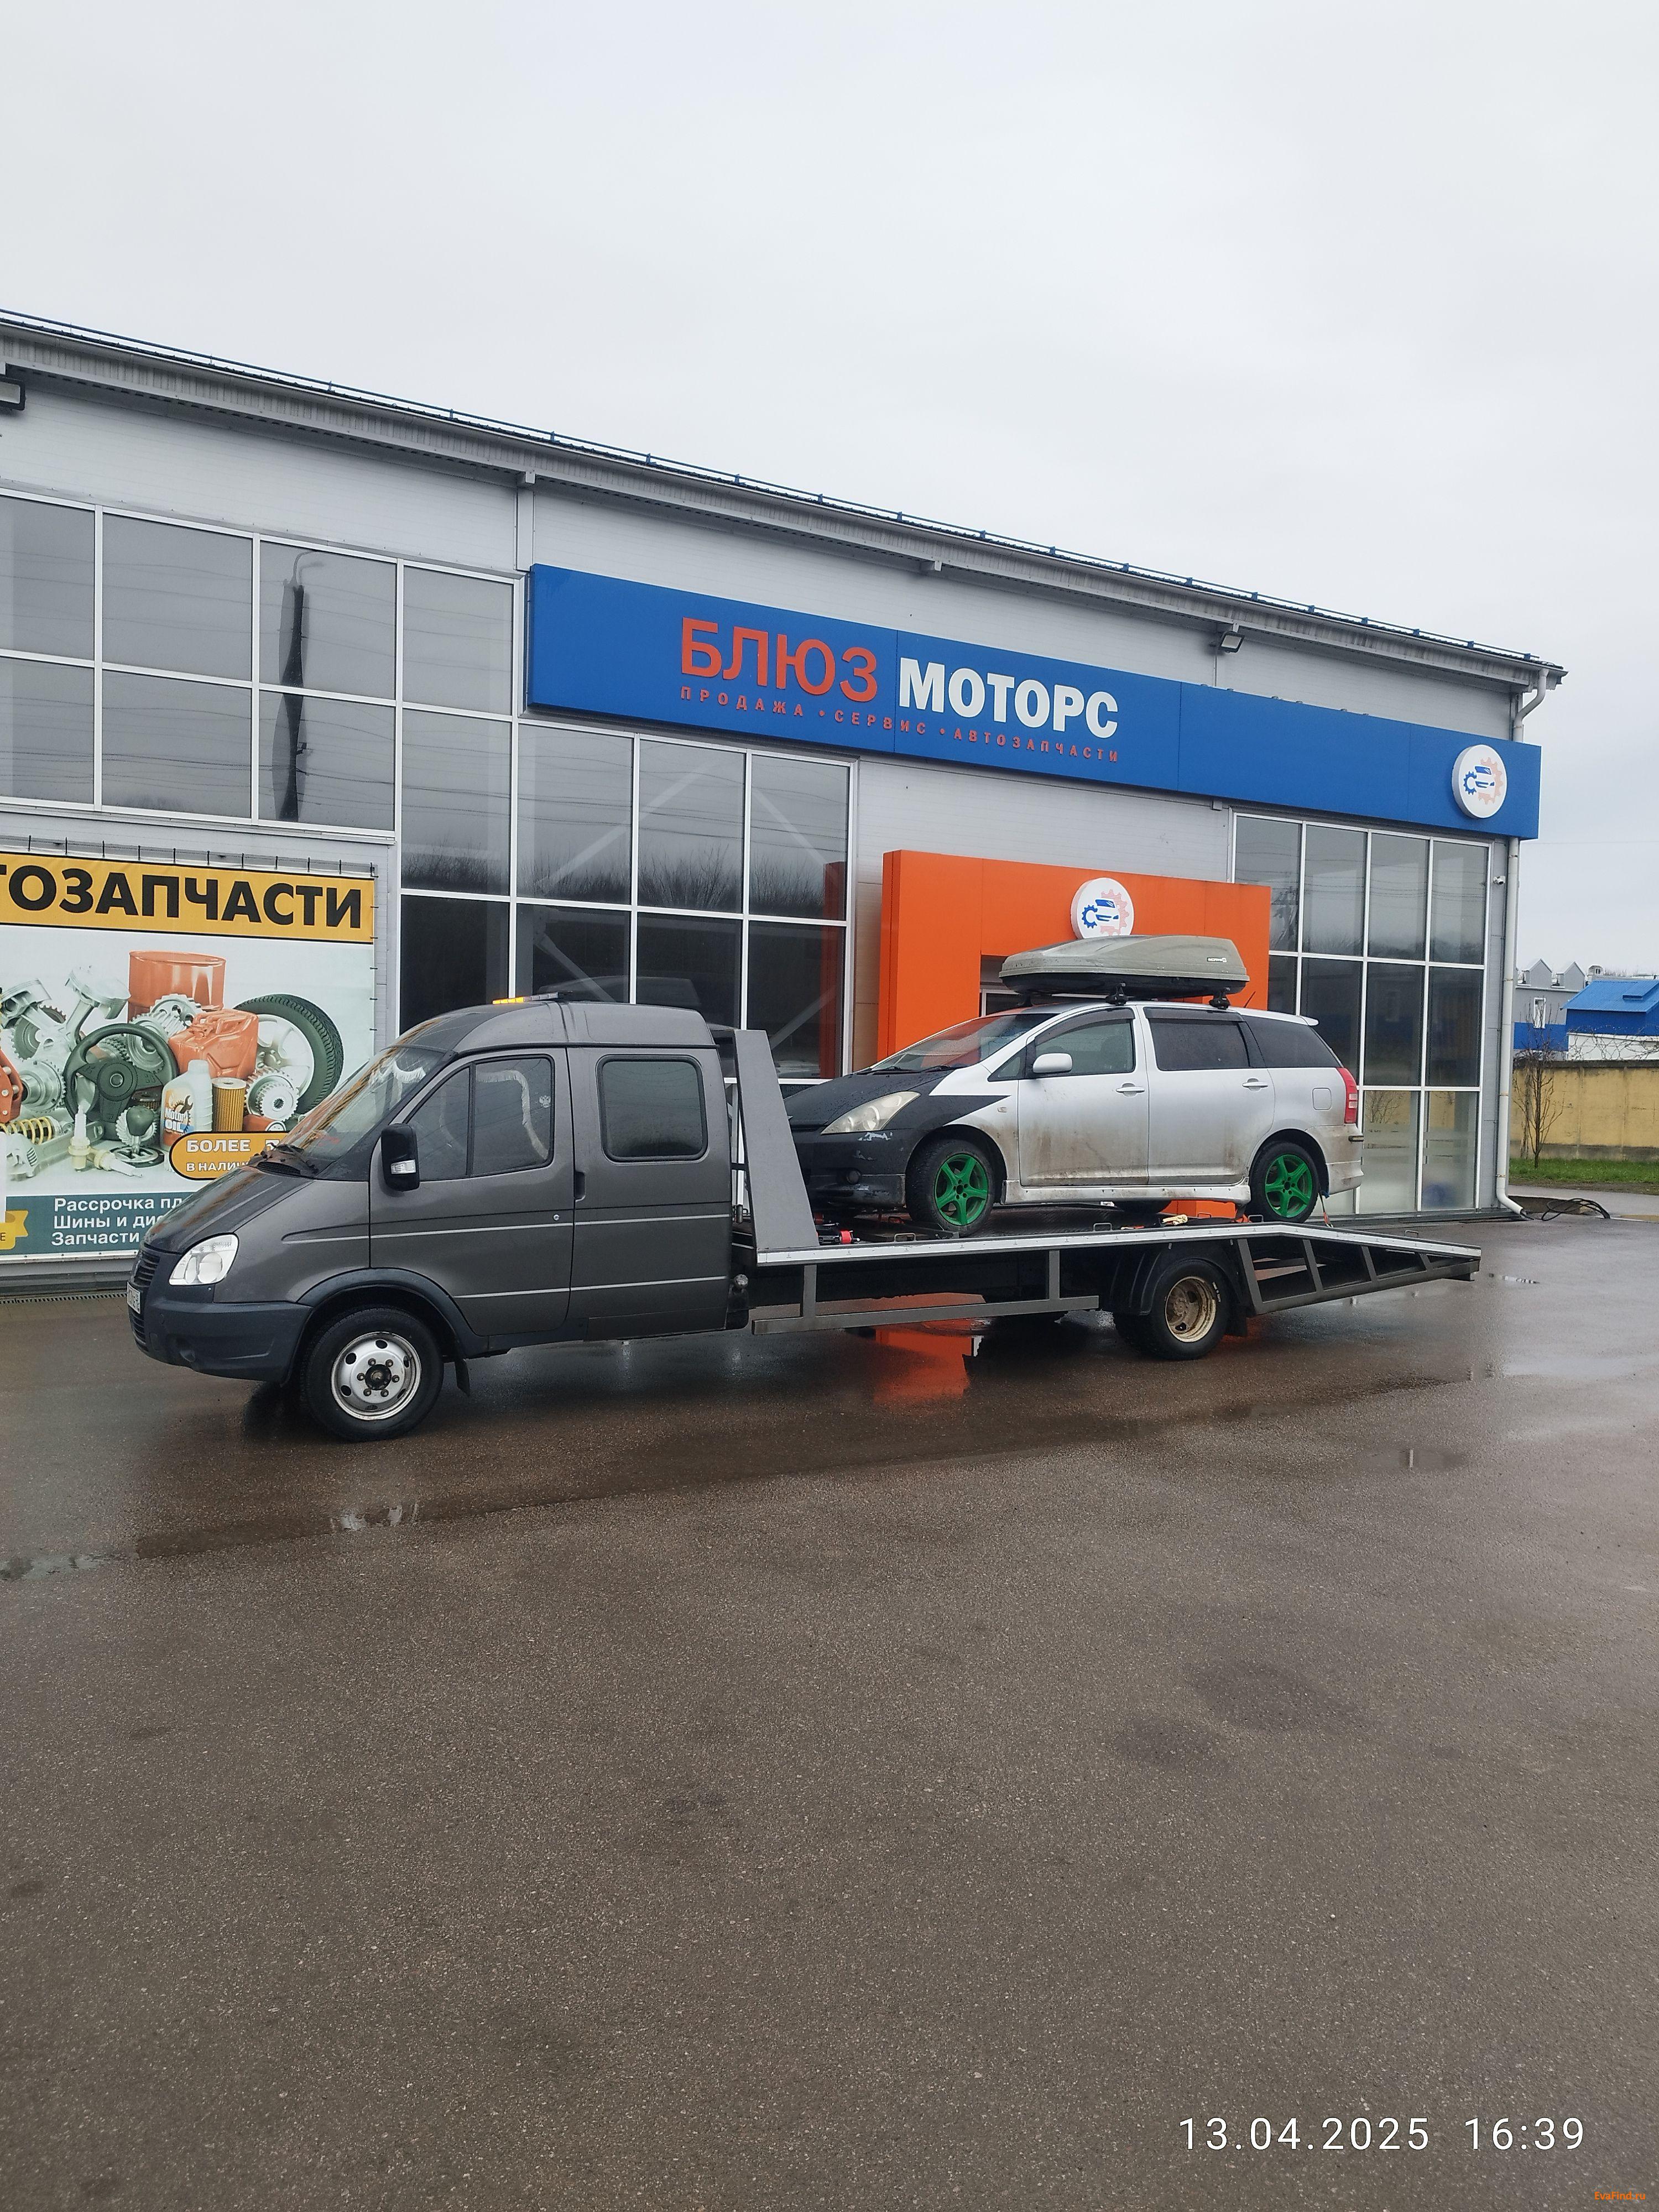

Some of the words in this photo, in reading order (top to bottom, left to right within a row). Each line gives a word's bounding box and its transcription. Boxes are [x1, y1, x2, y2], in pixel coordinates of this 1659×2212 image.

[681, 617, 878, 702] БЛЮЗ
[899, 658, 1118, 738] МОТОРС
[681, 686, 803, 717] ПРОДАЖА
[834, 709, 925, 734] СЕРВИС
[953, 728, 1117, 762] АВТОЗАПЧАСТИ
[0, 864, 361, 929] ОЗАПЧАСТИ
[165, 1119, 184, 1133] OIL
[186, 1139, 251, 1153] БОЛЕЕ
[186, 1162, 196, 1171] В
[54, 1198, 154, 1214] Рассрочка
[54, 1215, 111, 1229] Шины
[117, 1215, 127, 1228] и
[51, 1232, 139, 1246] Запчасти
